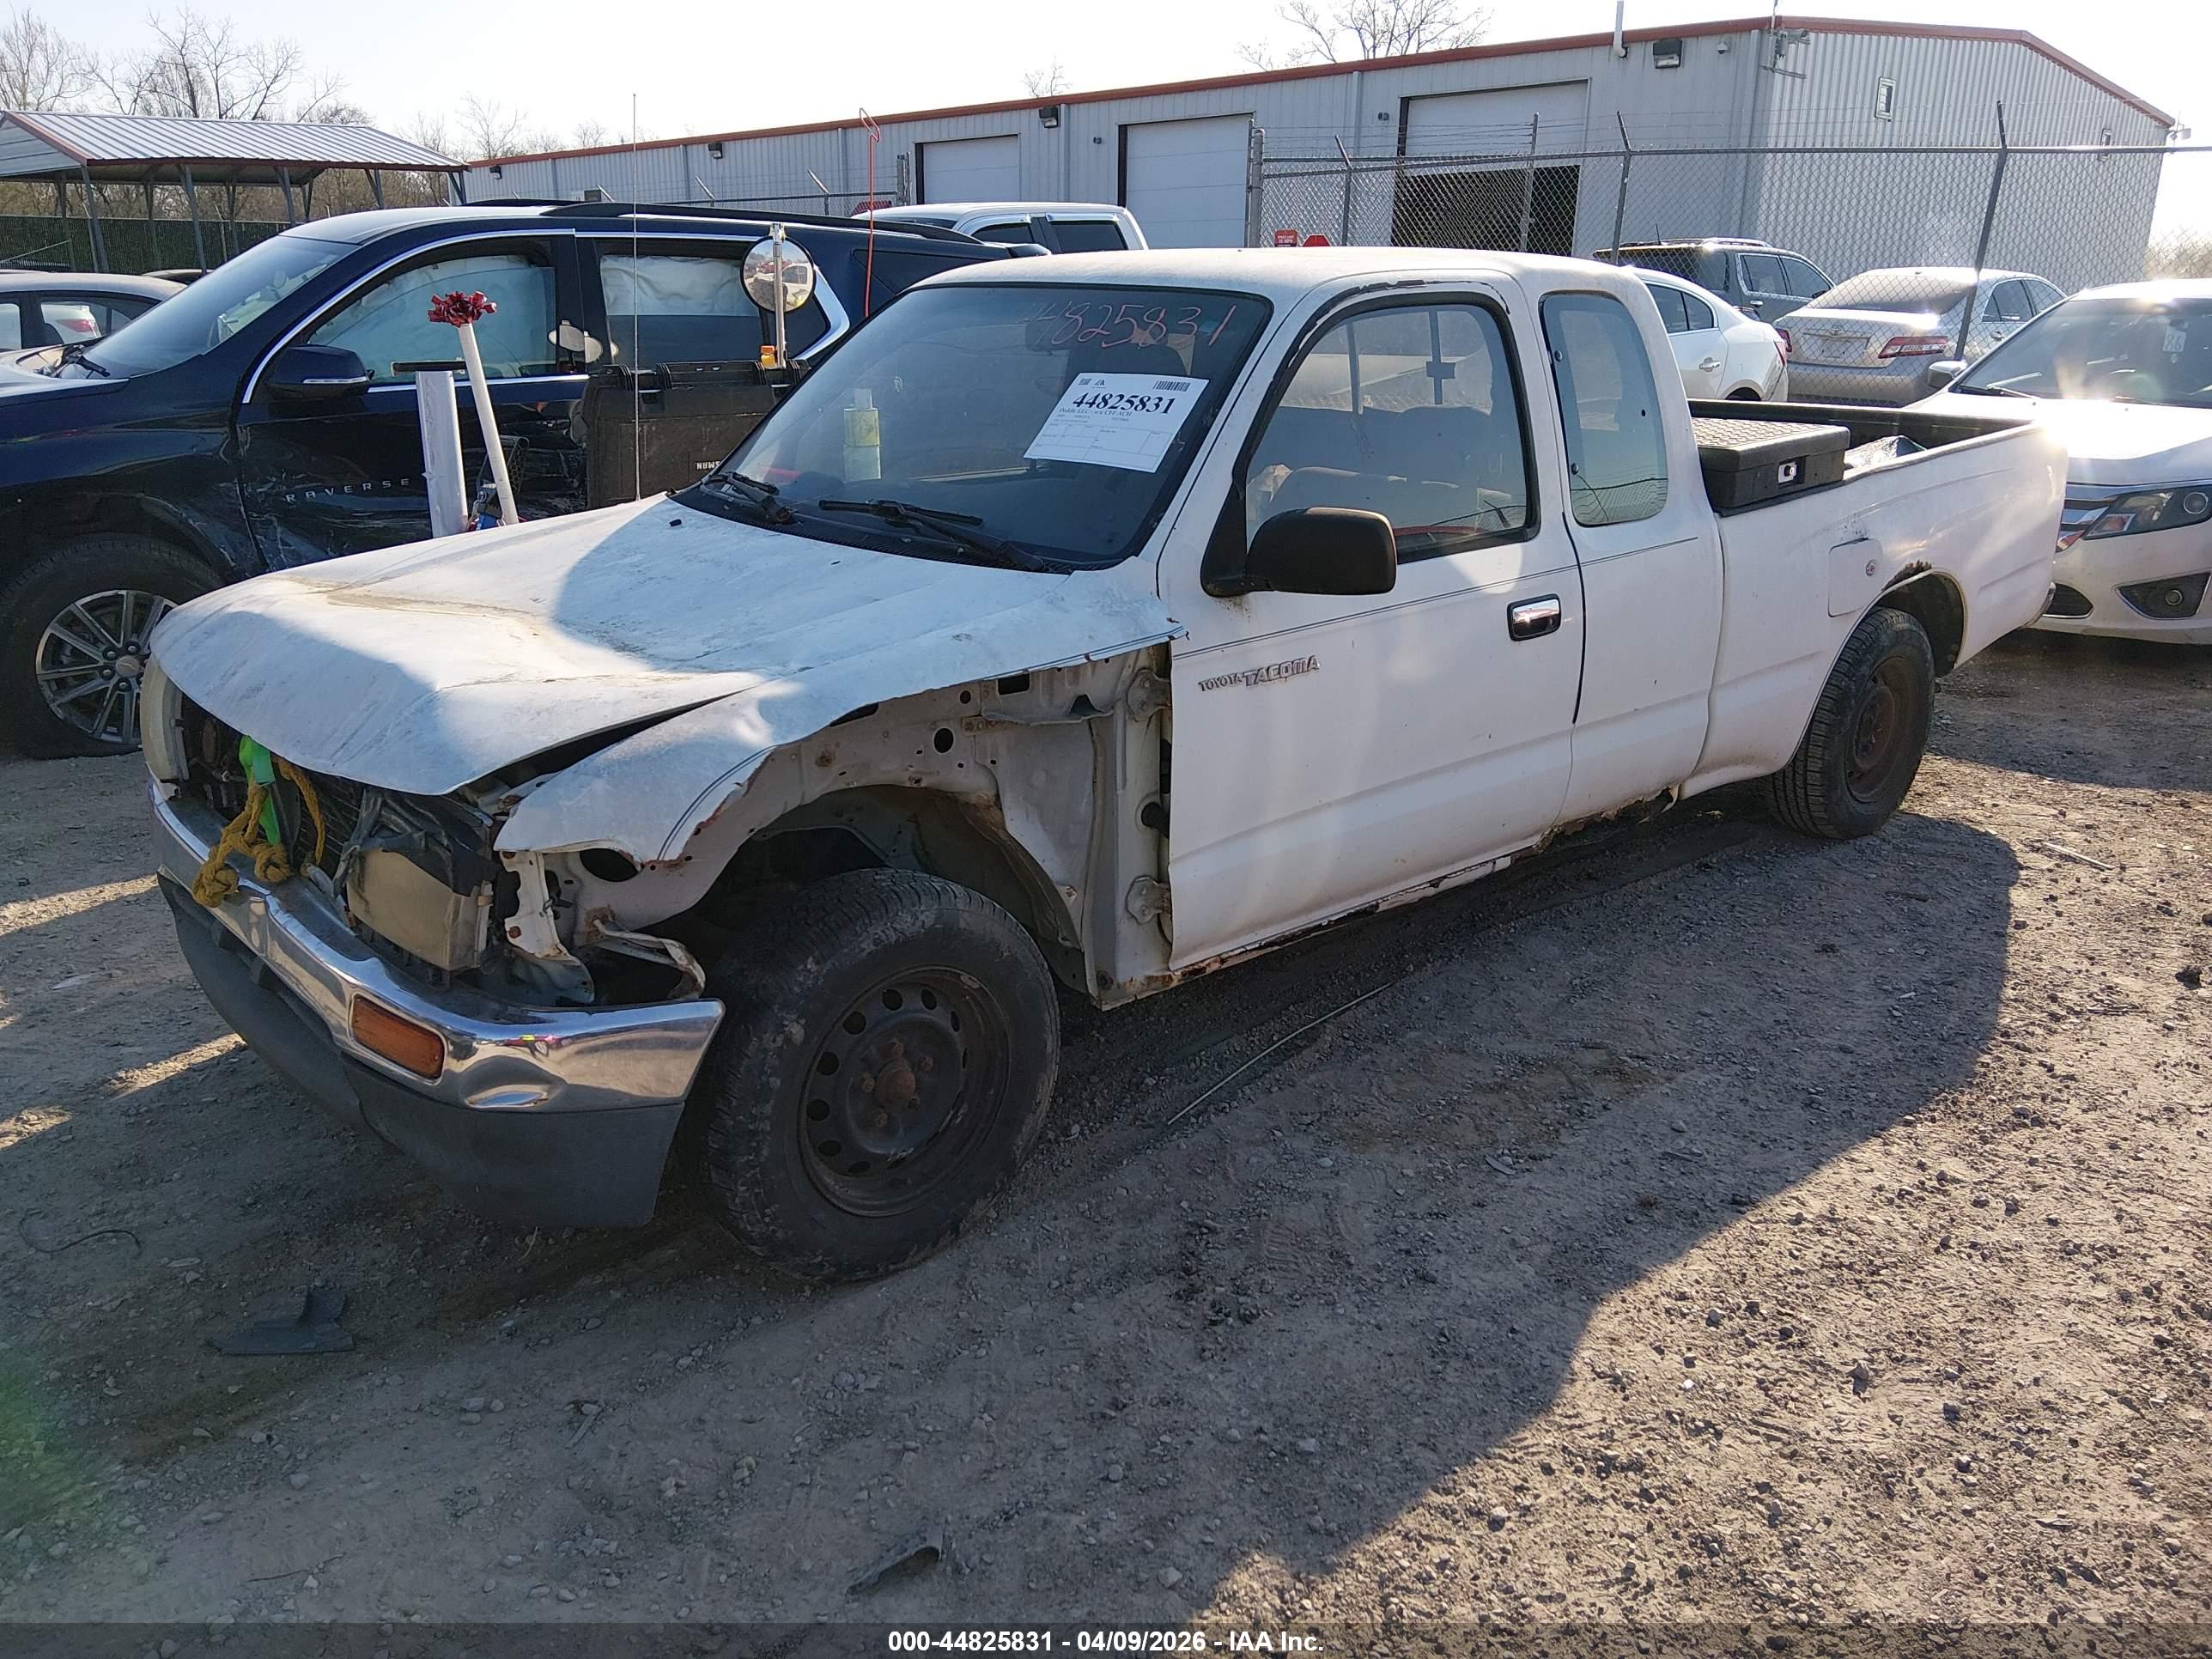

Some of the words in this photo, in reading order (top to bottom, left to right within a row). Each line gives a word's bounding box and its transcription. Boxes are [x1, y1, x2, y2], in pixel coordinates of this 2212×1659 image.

[1073, 392, 1176, 414] 44825831
[1198, 673, 1243, 692] TOYOTA
[1242, 655, 1321, 687] TACOMA
